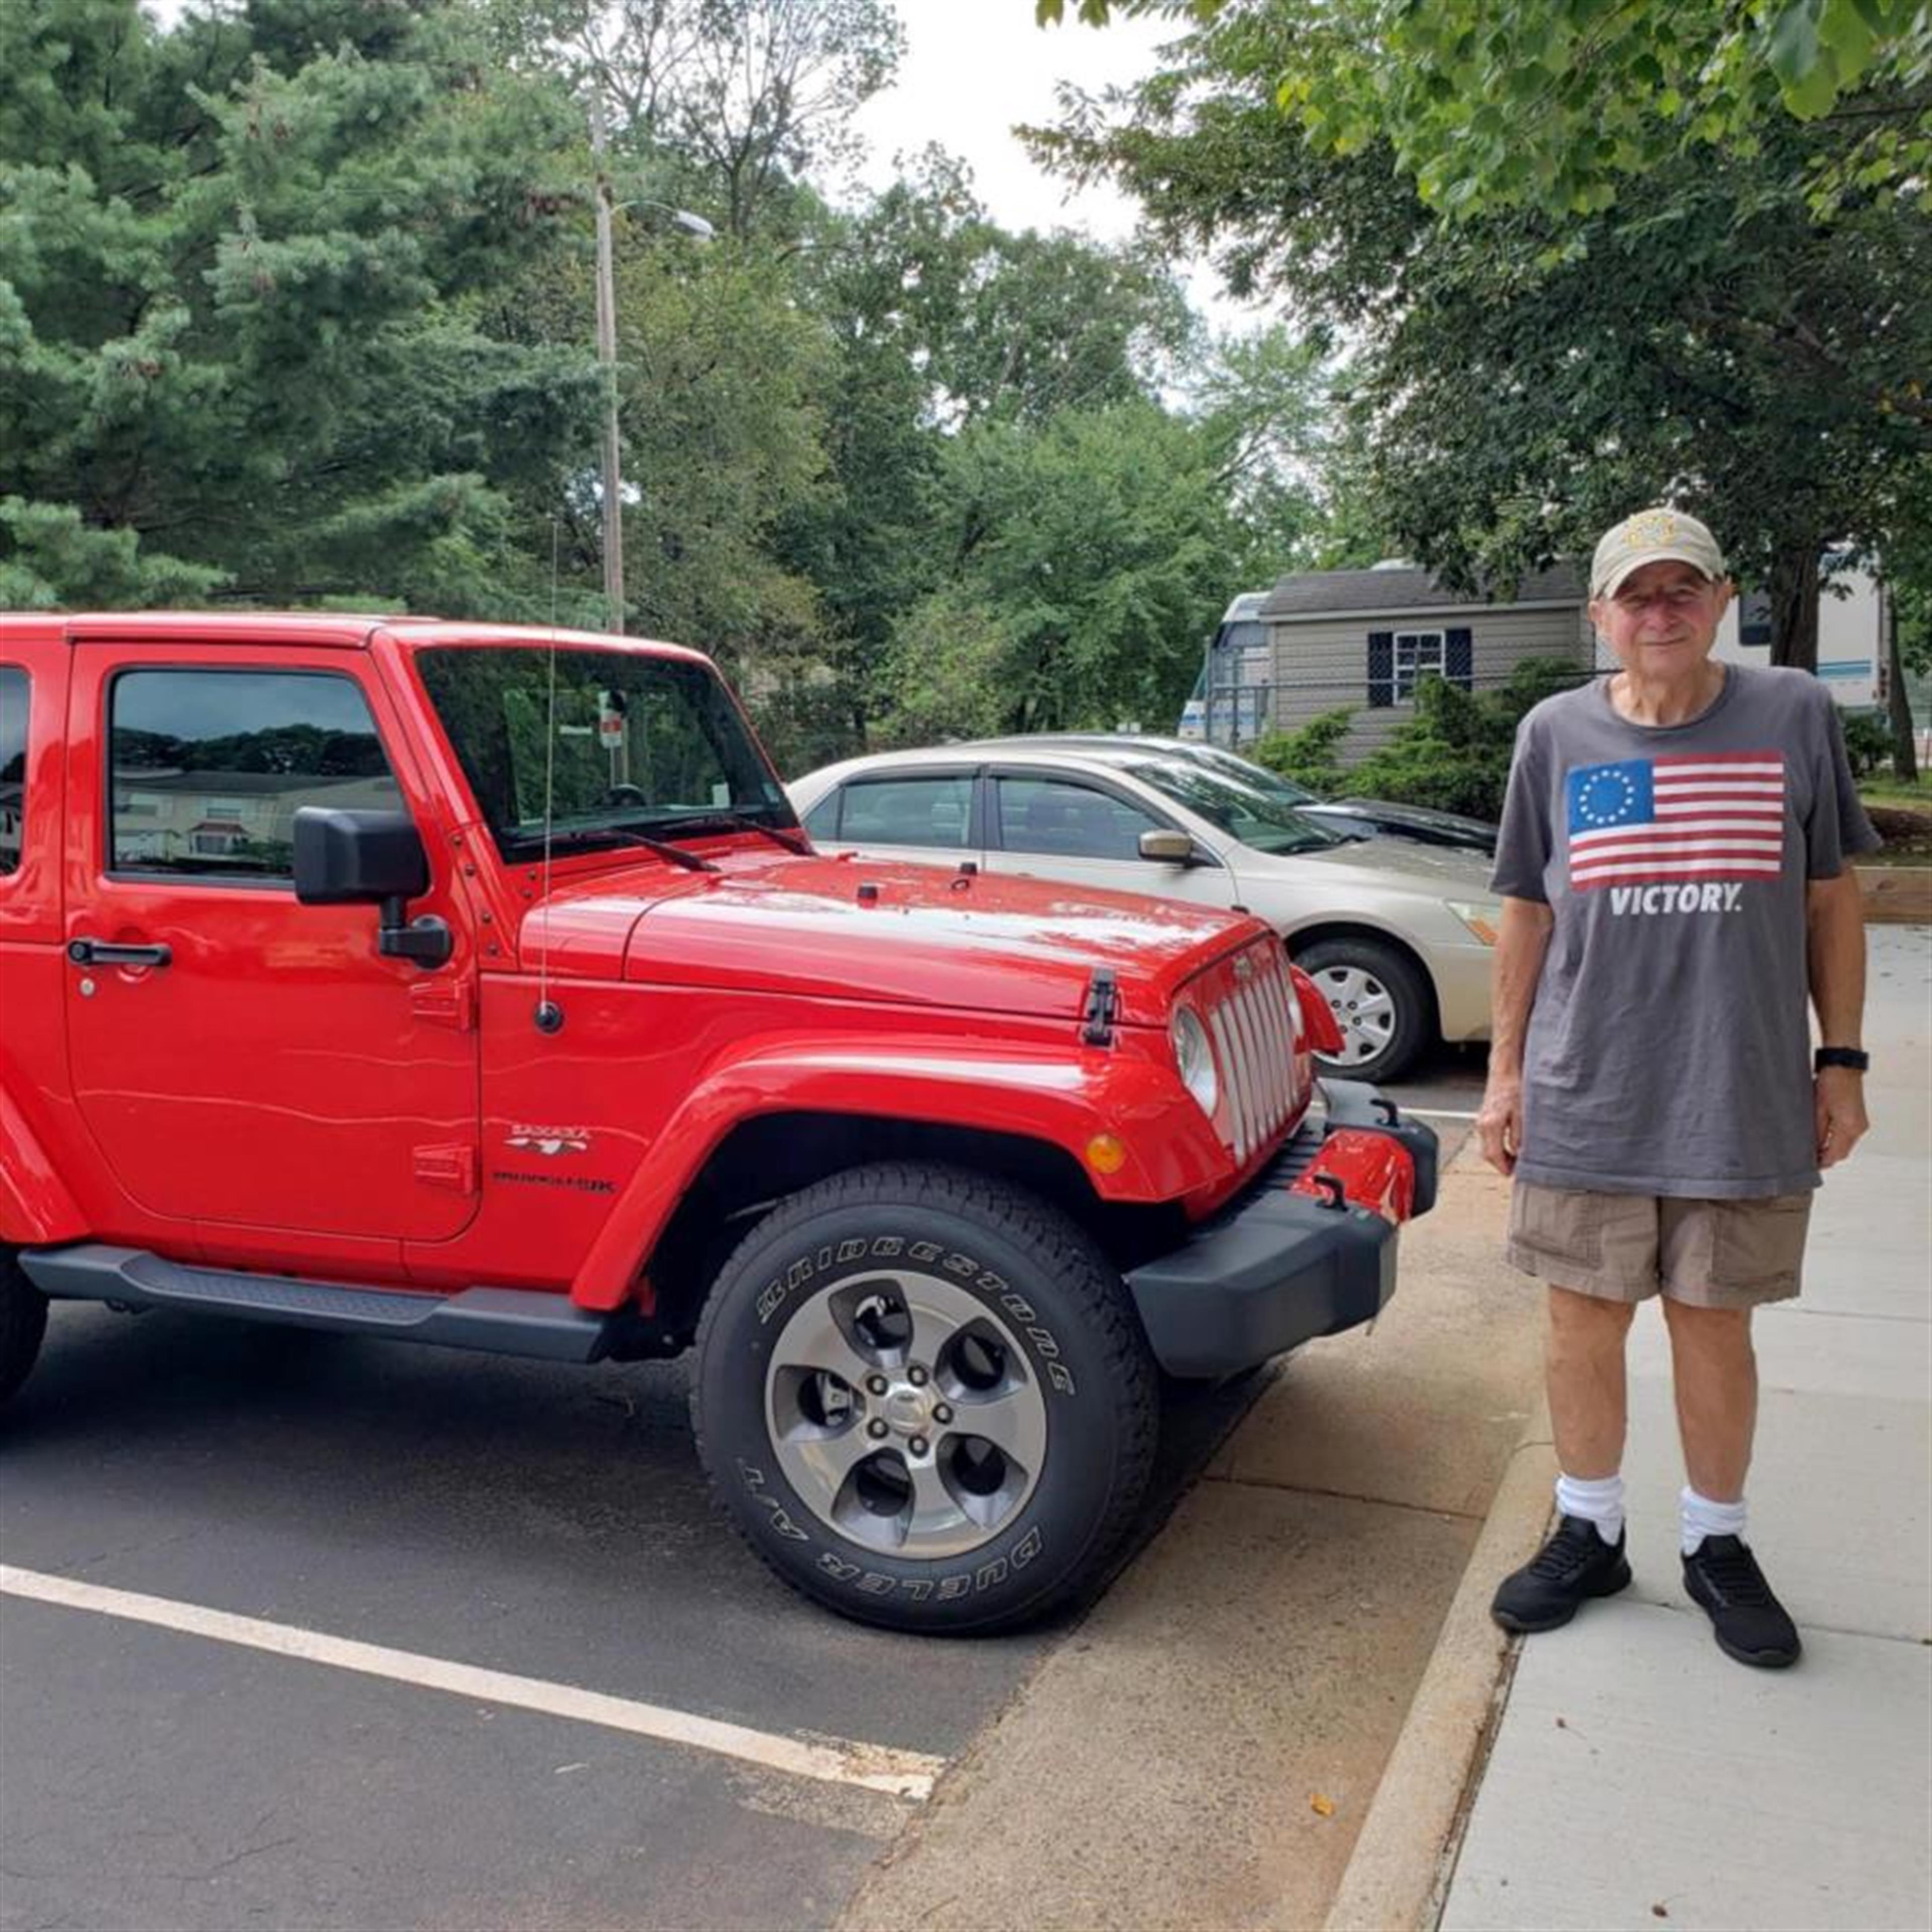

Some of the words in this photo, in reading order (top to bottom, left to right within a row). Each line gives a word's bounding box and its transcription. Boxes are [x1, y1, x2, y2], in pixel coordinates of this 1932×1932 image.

[1611, 882, 1743, 916] VICTORY.
[756, 1236, 1075, 1396] BRIDGESTONE
[815, 1525, 1043, 1601] DUELER
